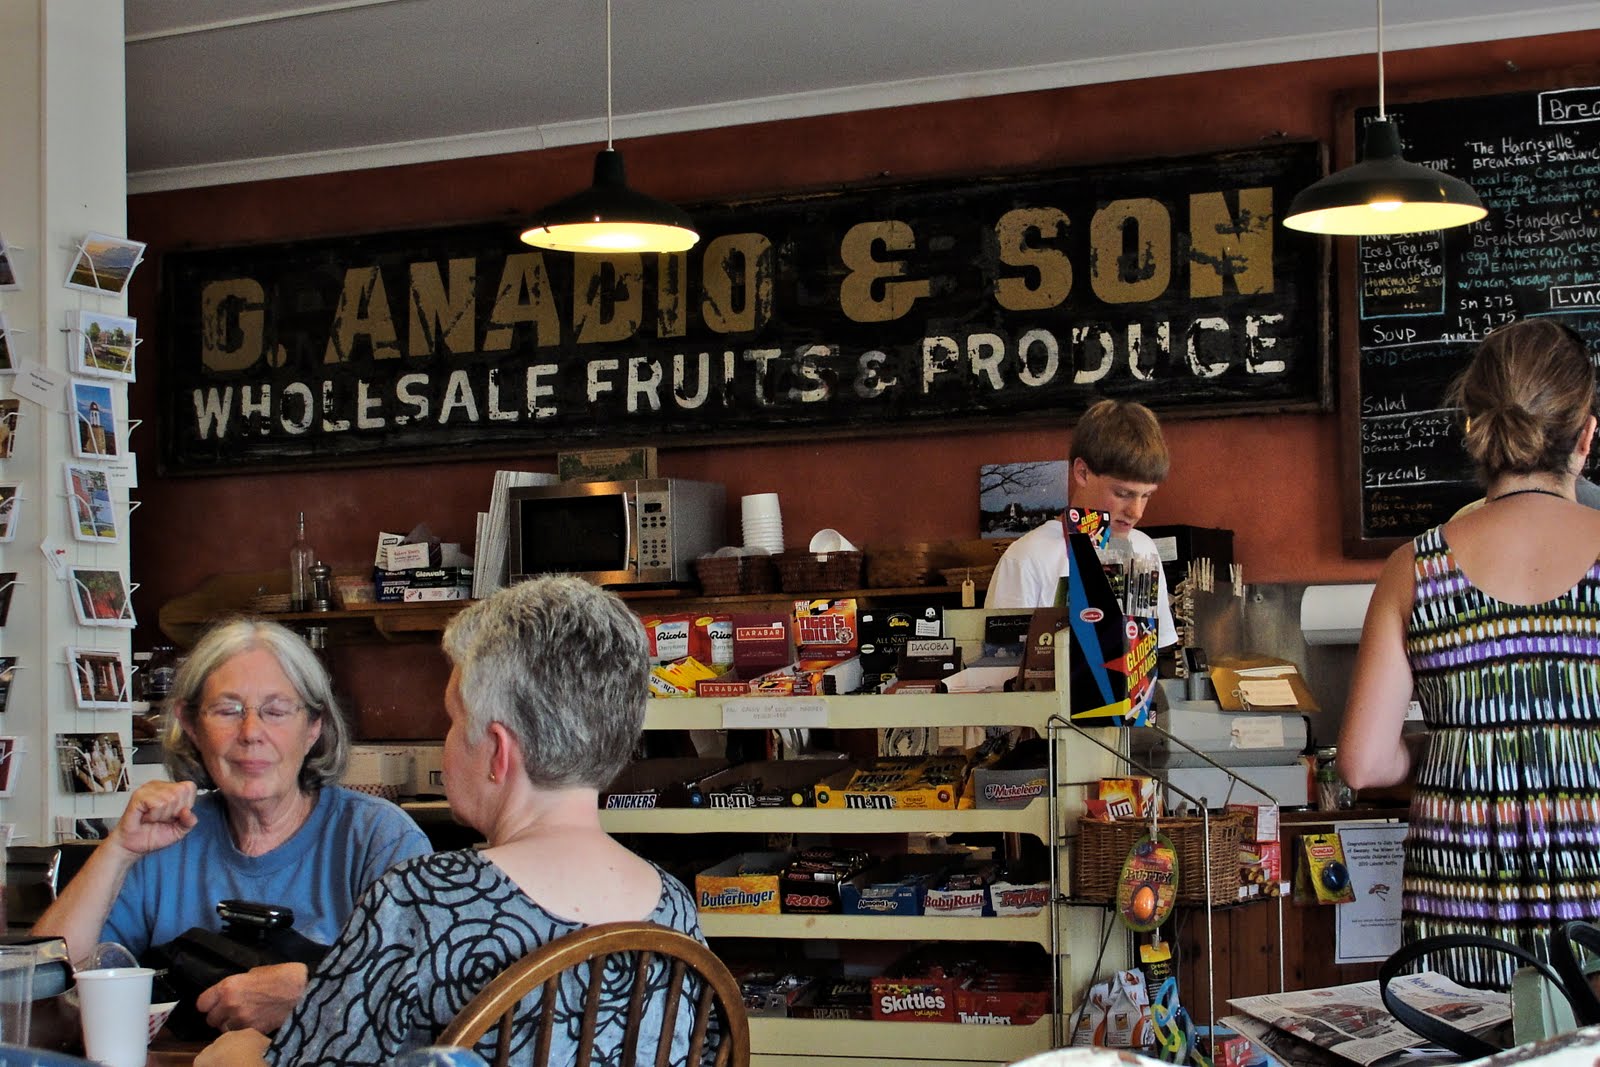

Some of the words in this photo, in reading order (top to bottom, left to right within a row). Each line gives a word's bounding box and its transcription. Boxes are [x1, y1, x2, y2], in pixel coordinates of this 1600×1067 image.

[1473, 152, 1541, 169] Breakfast
[1474, 229, 1546, 248] Breakfast
[1362, 244, 1392, 258] Iced
[1392, 241, 1417, 255] Tea
[1504, 246, 1563, 259] American
[1394, 253, 1432, 270] Coffee
[1539, 255, 1583, 270] Muffin
[202, 278, 288, 372] G.
[840, 220, 931, 323] &
[994, 186, 1274, 311] SON
[1365, 271, 1421, 288] Homemade
[1365, 285, 1419, 297] Lemonade
[1373, 324, 1416, 343] Soup
[193, 363, 559, 440] WHOLESALE
[587, 344, 839, 414] FRUITS
[852, 350, 897, 397] &
[921, 312, 1286, 394] PRODUCE
[1363, 393, 1407, 413] Salad
[1406, 438, 1434, 450] Salad
[1366, 464, 1426, 486] Specials
[798, 614, 845, 629] TIGER'S
[657, 631, 688, 641] Ricola
[740, 629, 781, 637] LARABAR
[911, 643, 949, 652] DAGOBA
[1126, 628, 1157, 672] GLIDERS
[1127, 669, 1139, 692] AND
[1138, 649, 1157, 680] PLANES
[703, 685, 744, 693] LARABAR
[993, 783, 1042, 799] Musketeers
[606, 793, 657, 809] SNICKERS
[1125, 868, 1174, 884] PUTTY
[701, 889, 775, 908] Butterfinger
[786, 893, 829, 907] Rolo
[858, 899, 885, 910] Almond
[881, 993, 946, 1014] Skittles
[914, 1010, 943, 1018] ORIGINAL
[958, 1012, 1011, 1025] Twizzlers
